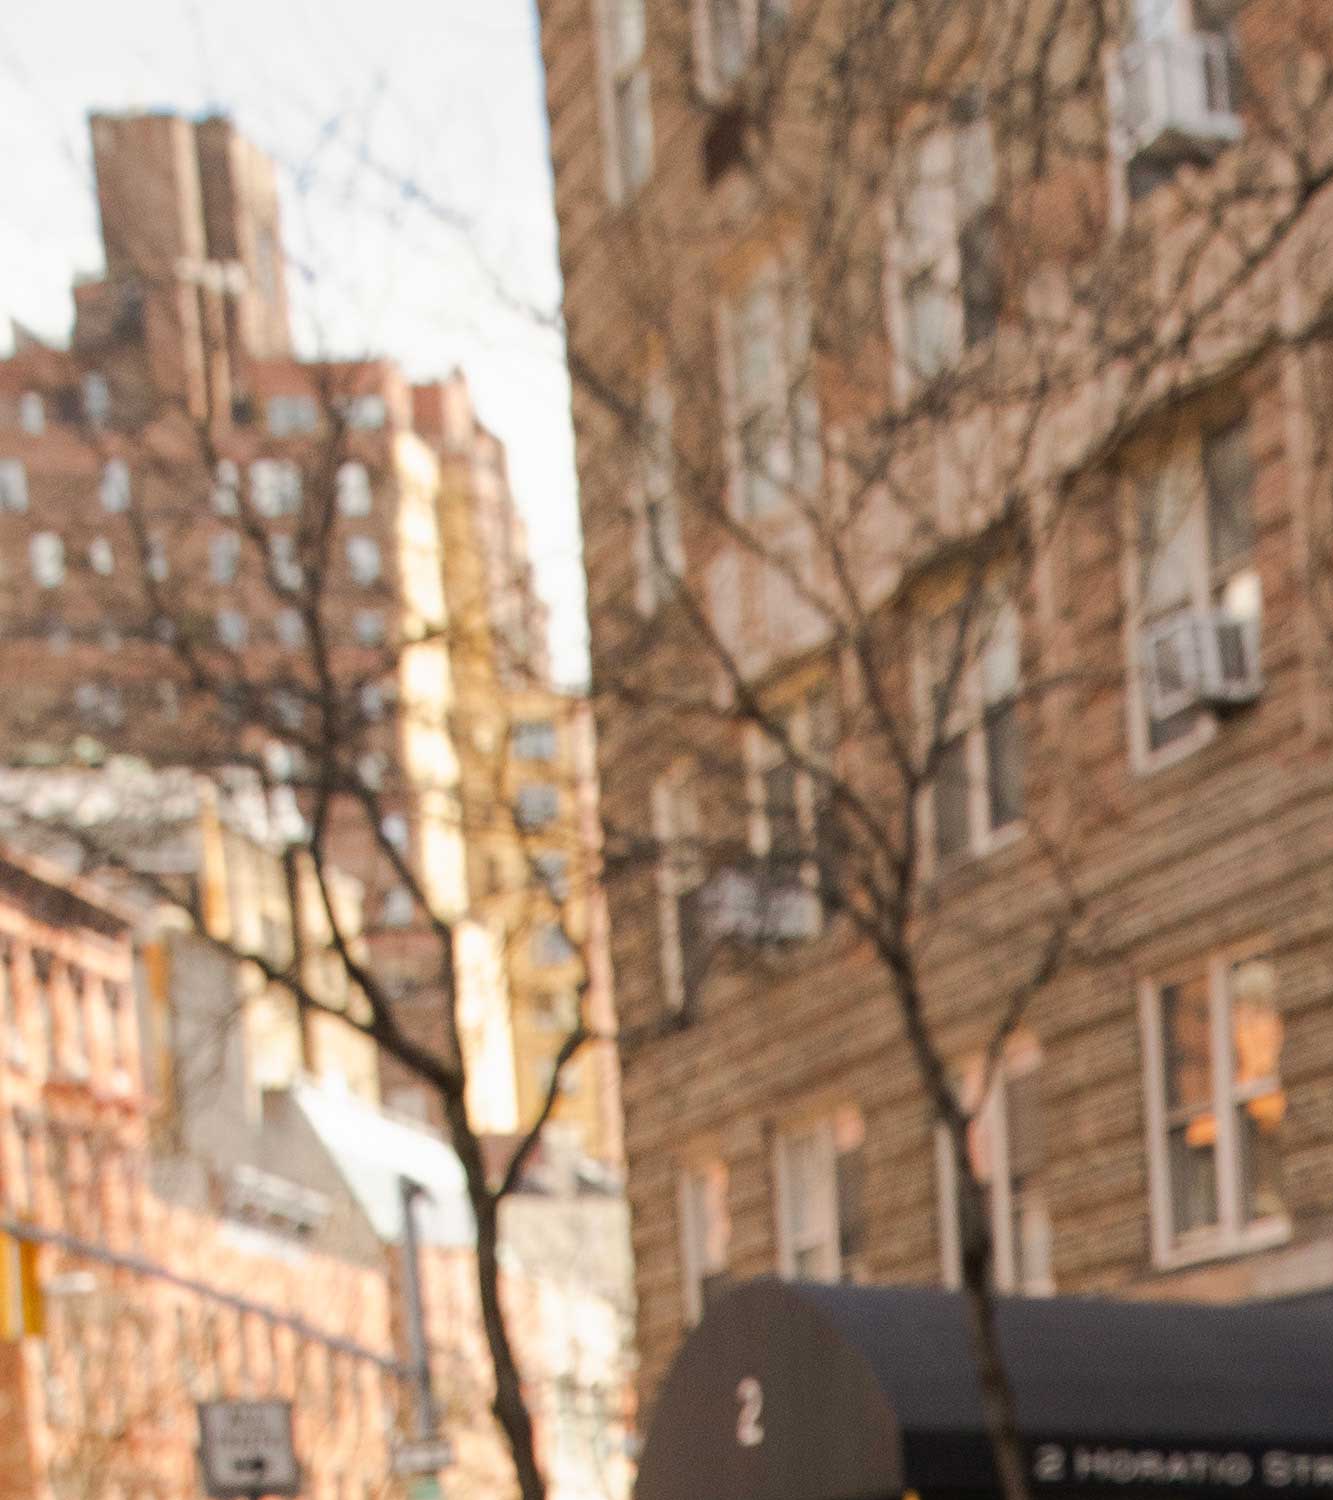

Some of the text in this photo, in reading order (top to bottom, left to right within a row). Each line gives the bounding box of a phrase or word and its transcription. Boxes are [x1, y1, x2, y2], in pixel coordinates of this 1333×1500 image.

[736, 1376, 764, 1447] 2
[1033, 1442, 1066, 1483] 2
[1073, 1446, 1254, 1487] HORATIO
